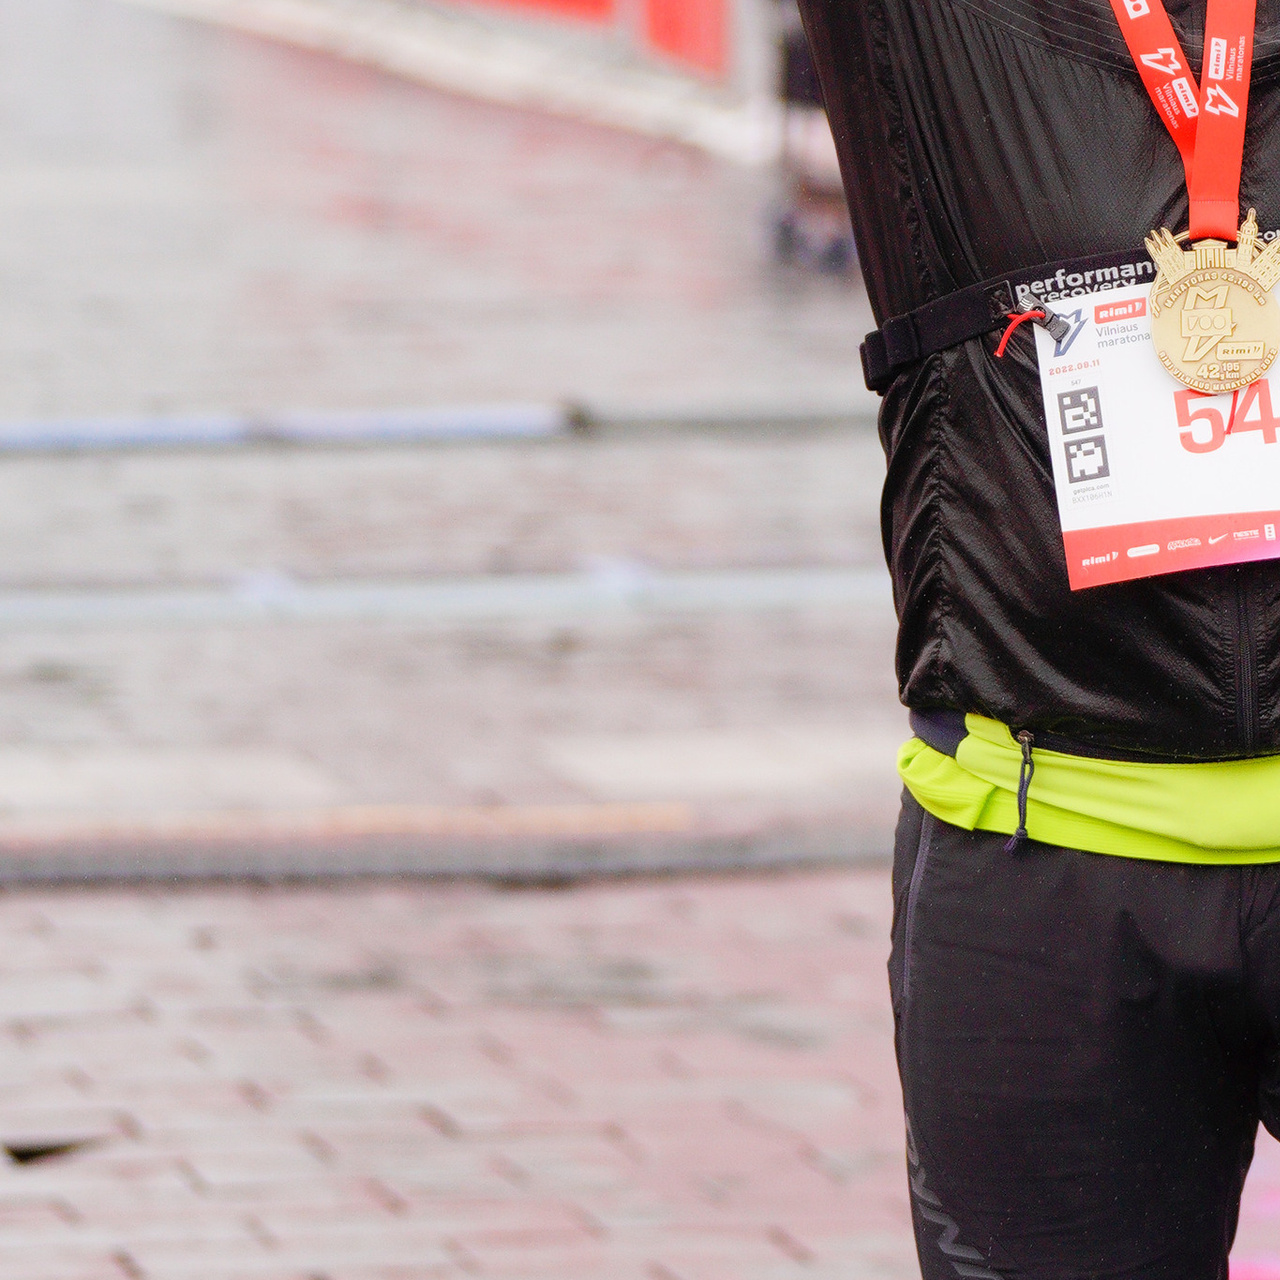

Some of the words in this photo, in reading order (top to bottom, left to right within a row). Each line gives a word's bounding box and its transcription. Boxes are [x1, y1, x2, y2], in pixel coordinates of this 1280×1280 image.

[1015, 260, 1157, 300] performan
[1164, 272, 1219, 308] MARATONAS
[1095, 322, 1138, 337] Vilniaus
[1097, 333, 1151, 349] maratona
[1173, 368, 1213, 390] VILNIAUS
[1212, 368, 1262, 391] MARATONAS
